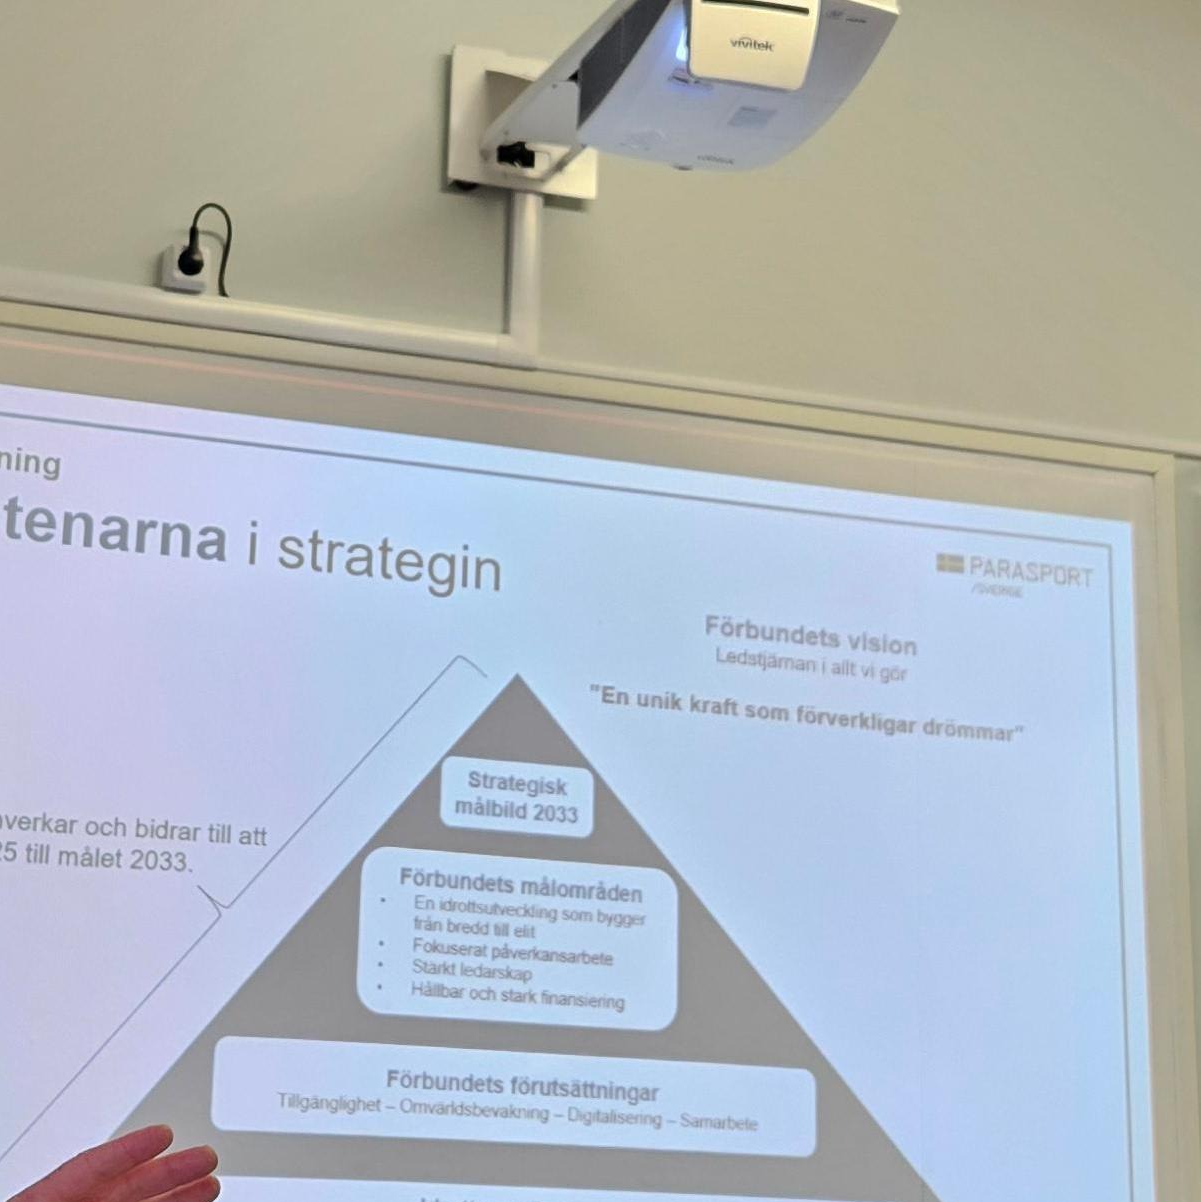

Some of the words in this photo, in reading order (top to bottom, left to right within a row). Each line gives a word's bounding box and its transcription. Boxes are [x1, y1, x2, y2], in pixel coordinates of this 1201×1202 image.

[729, 36, 775, 52] vivitek
[248, 520, 258, 565] i
[278, 529, 501, 598] strategin
[970, 556, 1094, 587] PARASPORT
[705, 614, 841, 648] Förbundets
[848, 631, 918, 656] vision
[715, 646, 816, 671] Ledstjärnan
[821, 660, 827, 675] i
[831, 659, 856, 677] allt
[861, 663, 875, 679] vi
[880, 666, 908, 684] gör
[637, 691, 683, 711] unik
[690, 694, 739, 717] kraft
[745, 704, 789, 722] som
[796, 705, 918, 737] förverkligar
[468, 770, 568, 798] Strategisk
[455, 796, 528, 820] målbild
[533, 803, 579, 824] 2033
[85, 817, 127, 837] och
[135, 818, 201, 842] bidrar
[208, 823, 232, 844] till
[239, 826, 267, 847] att
[26, 843, 51, 864] till
[58, 846, 123, 869] målet
[130, 849, 194, 872] 2033.
[399, 867, 515, 893] Förbundets
[521, 875, 643, 903] målområden
[414, 895, 436, 911] En
[439, 896, 558, 923] idrottsutveckling
[561, 910, 593, 922] som
[596, 909, 646, 928] bygger
[414, 917, 442, 932] från
[446, 917, 489, 935] bredd
[493, 921, 510, 938] till
[514, 923, 536, 939] elit
[413, 937, 488, 957] Fokuserat
[491, 942, 614, 967] påverkansarbete
[460, 963, 533, 983] ledarskap
[411, 981, 464, 999] Hållbar
[469, 986, 497, 1001] och
[501, 988, 537, 1004] stark
[541, 990, 626, 1013] finansiering
[387, 1069, 504, 1094] Förbundets
[510, 1076, 661, 1105] förutsättningar
[277, 1092, 382, 1115] Tillgänglighet
[399, 1098, 550, 1124] Omvärldsbevakning
[568, 1106, 663, 1130] Digitalisering
[680, 1113, 759, 1132] Samarbete
